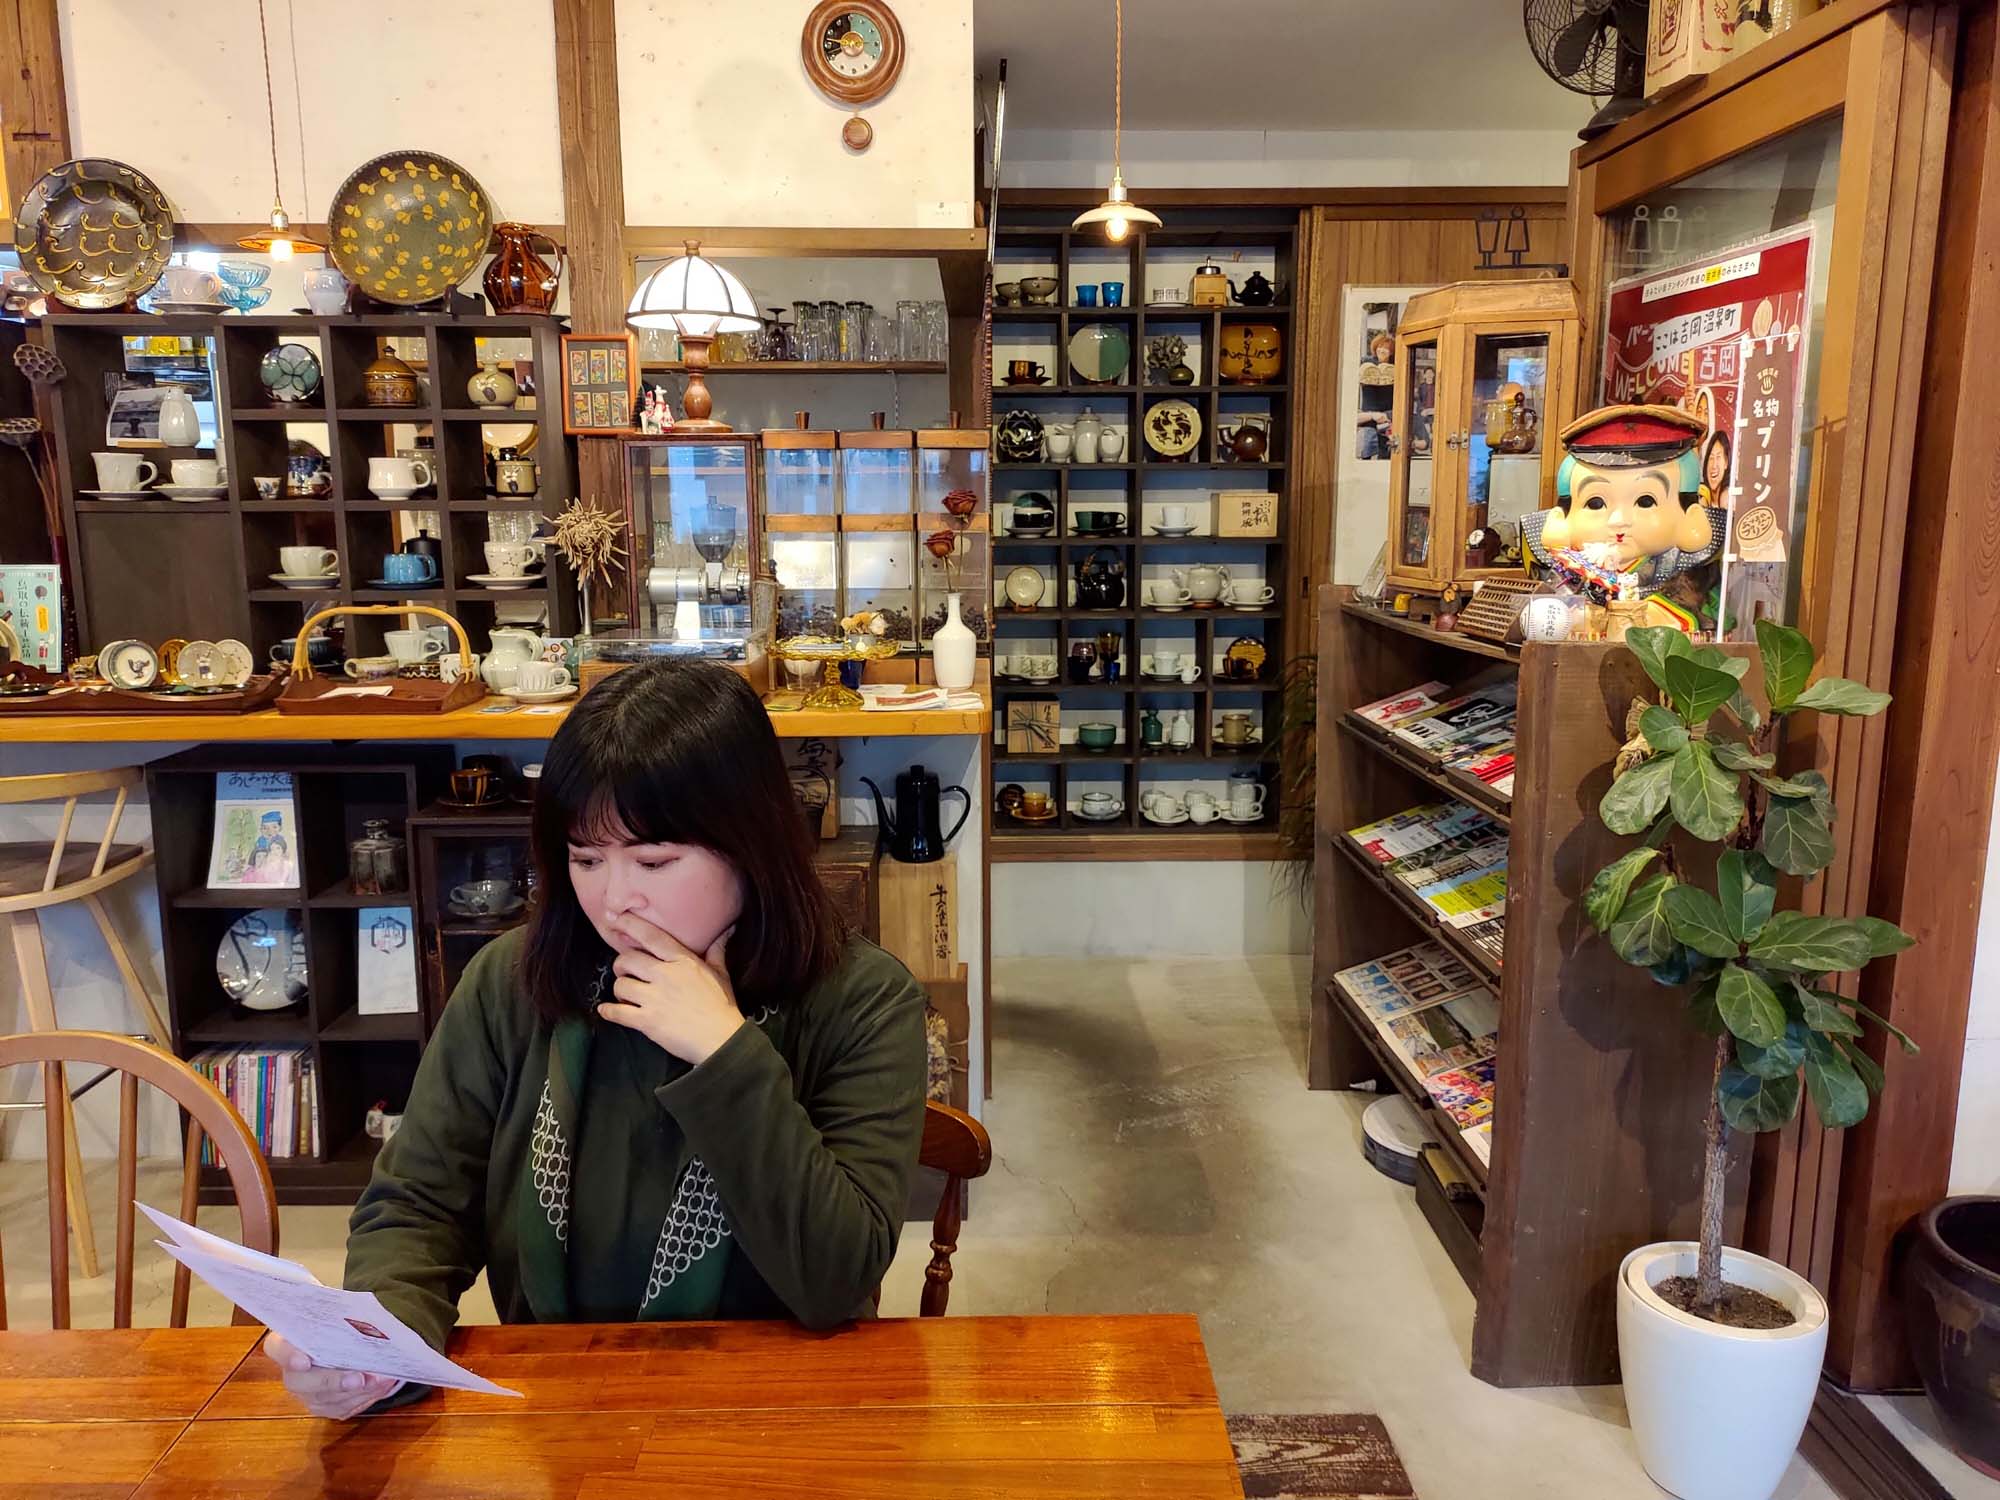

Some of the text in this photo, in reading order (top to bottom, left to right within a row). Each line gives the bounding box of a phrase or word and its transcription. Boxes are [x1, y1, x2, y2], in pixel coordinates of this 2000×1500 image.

[1655, 307, 1737, 351] ここは吉岡温泉町
[1752, 399, 1780, 418] 名物
[1754, 420, 1777, 504] プリン
